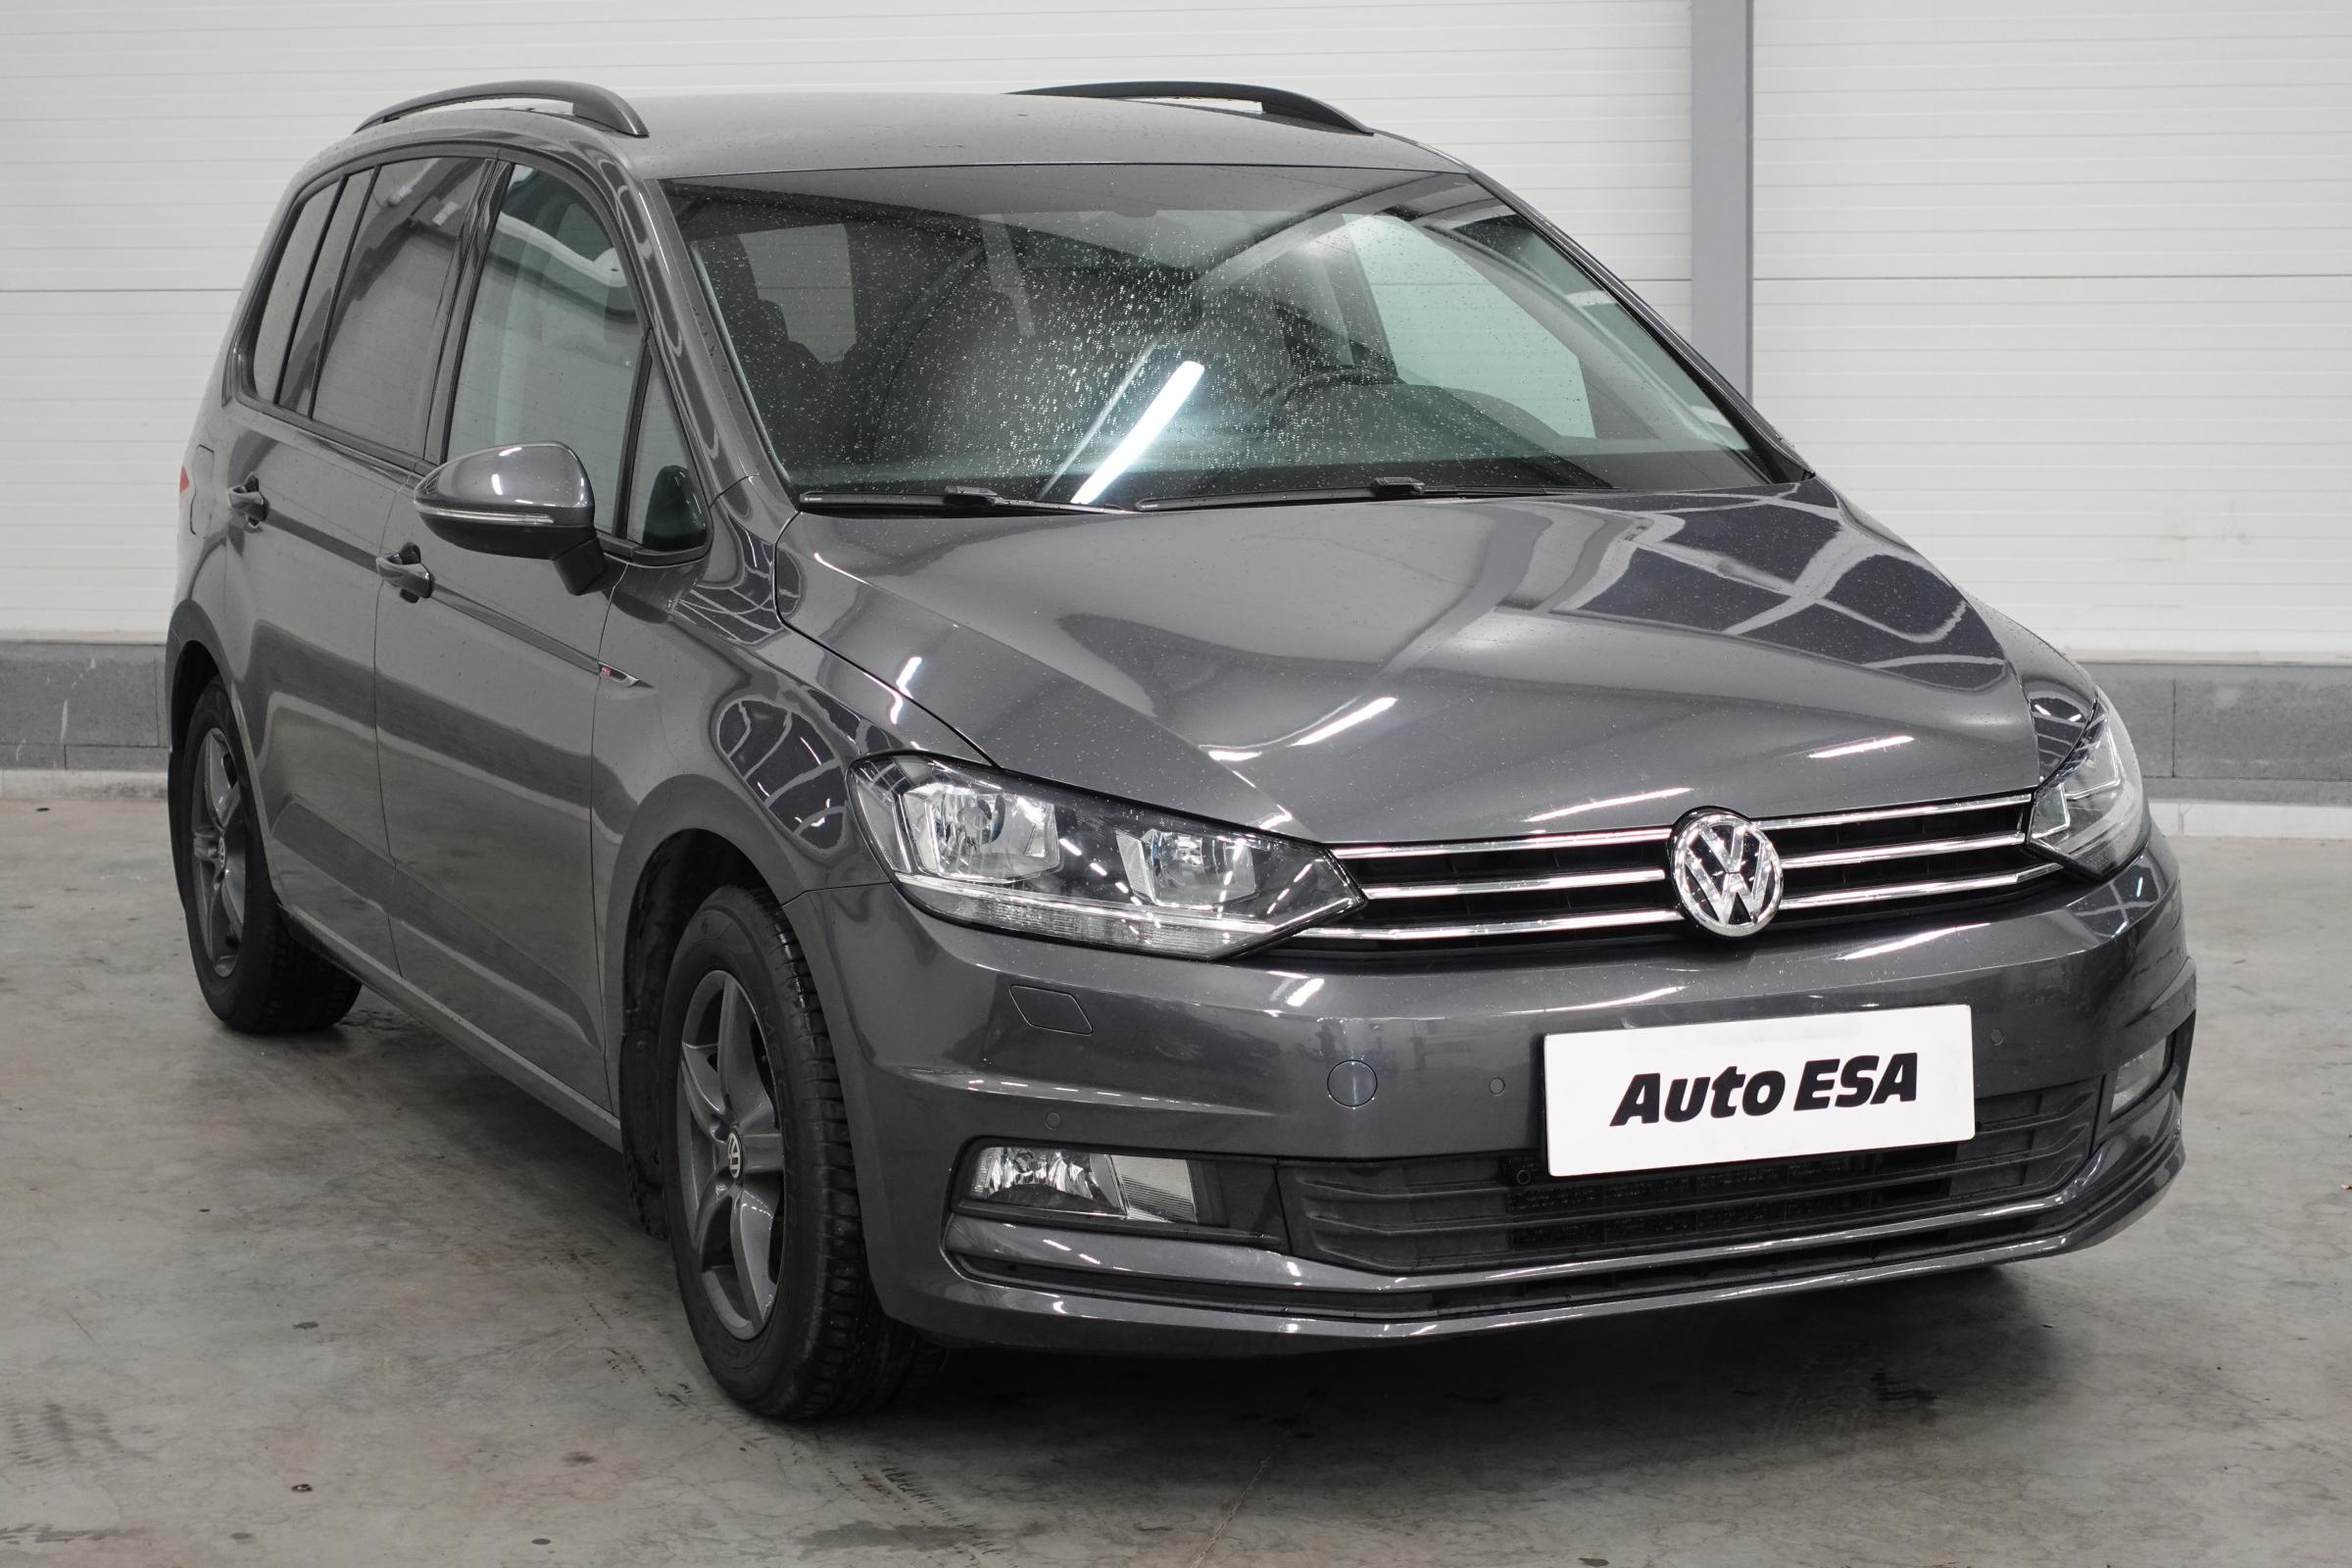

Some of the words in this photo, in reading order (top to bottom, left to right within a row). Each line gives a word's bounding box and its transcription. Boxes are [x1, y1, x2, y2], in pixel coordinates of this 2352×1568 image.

[1682, 818, 1777, 929] VW
[1609, 1065, 1786, 1127] Auto
[1793, 1052, 1918, 1111] ESA
